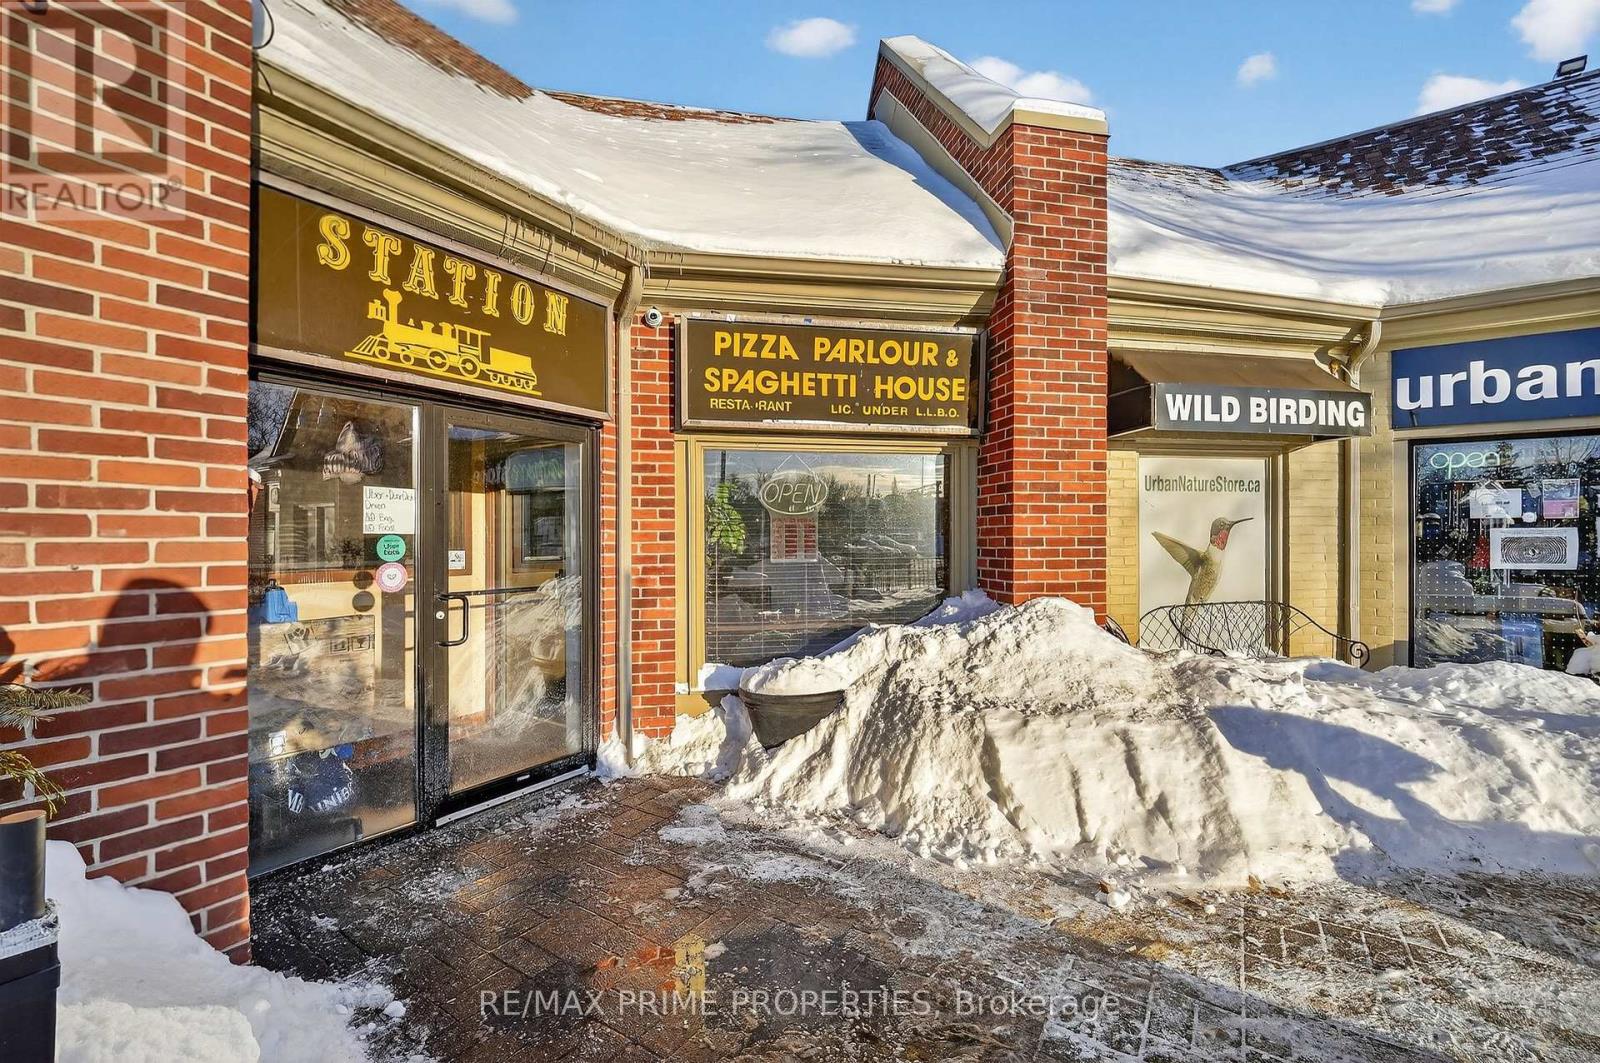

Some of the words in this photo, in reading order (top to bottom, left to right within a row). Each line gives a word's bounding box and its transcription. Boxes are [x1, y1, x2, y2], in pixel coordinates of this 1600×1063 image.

[317, 214, 569, 336] STATION
[714, 331, 799, 361] PIZZA
[814, 337, 938, 367] PARLOUR
[946, 350, 959, 367] &
[704, 368, 857, 398] SPAGHETTI
[875, 376, 966, 401] HOUSE
[1396, 358, 1600, 410] urban
[710, 398, 792, 412] RESTARANT
[863, 406, 908, 416] UNDER
[916, 407, 960, 418] L.L.B.O.
[1165, 394, 1241, 423] WILD
[1250, 397, 1365, 427] BIRDING
[1430, 452, 1501, 479] open
[764, 483, 821, 503] OPEN
[1144, 475, 1261, 492] UrbanNatureStore.ca
